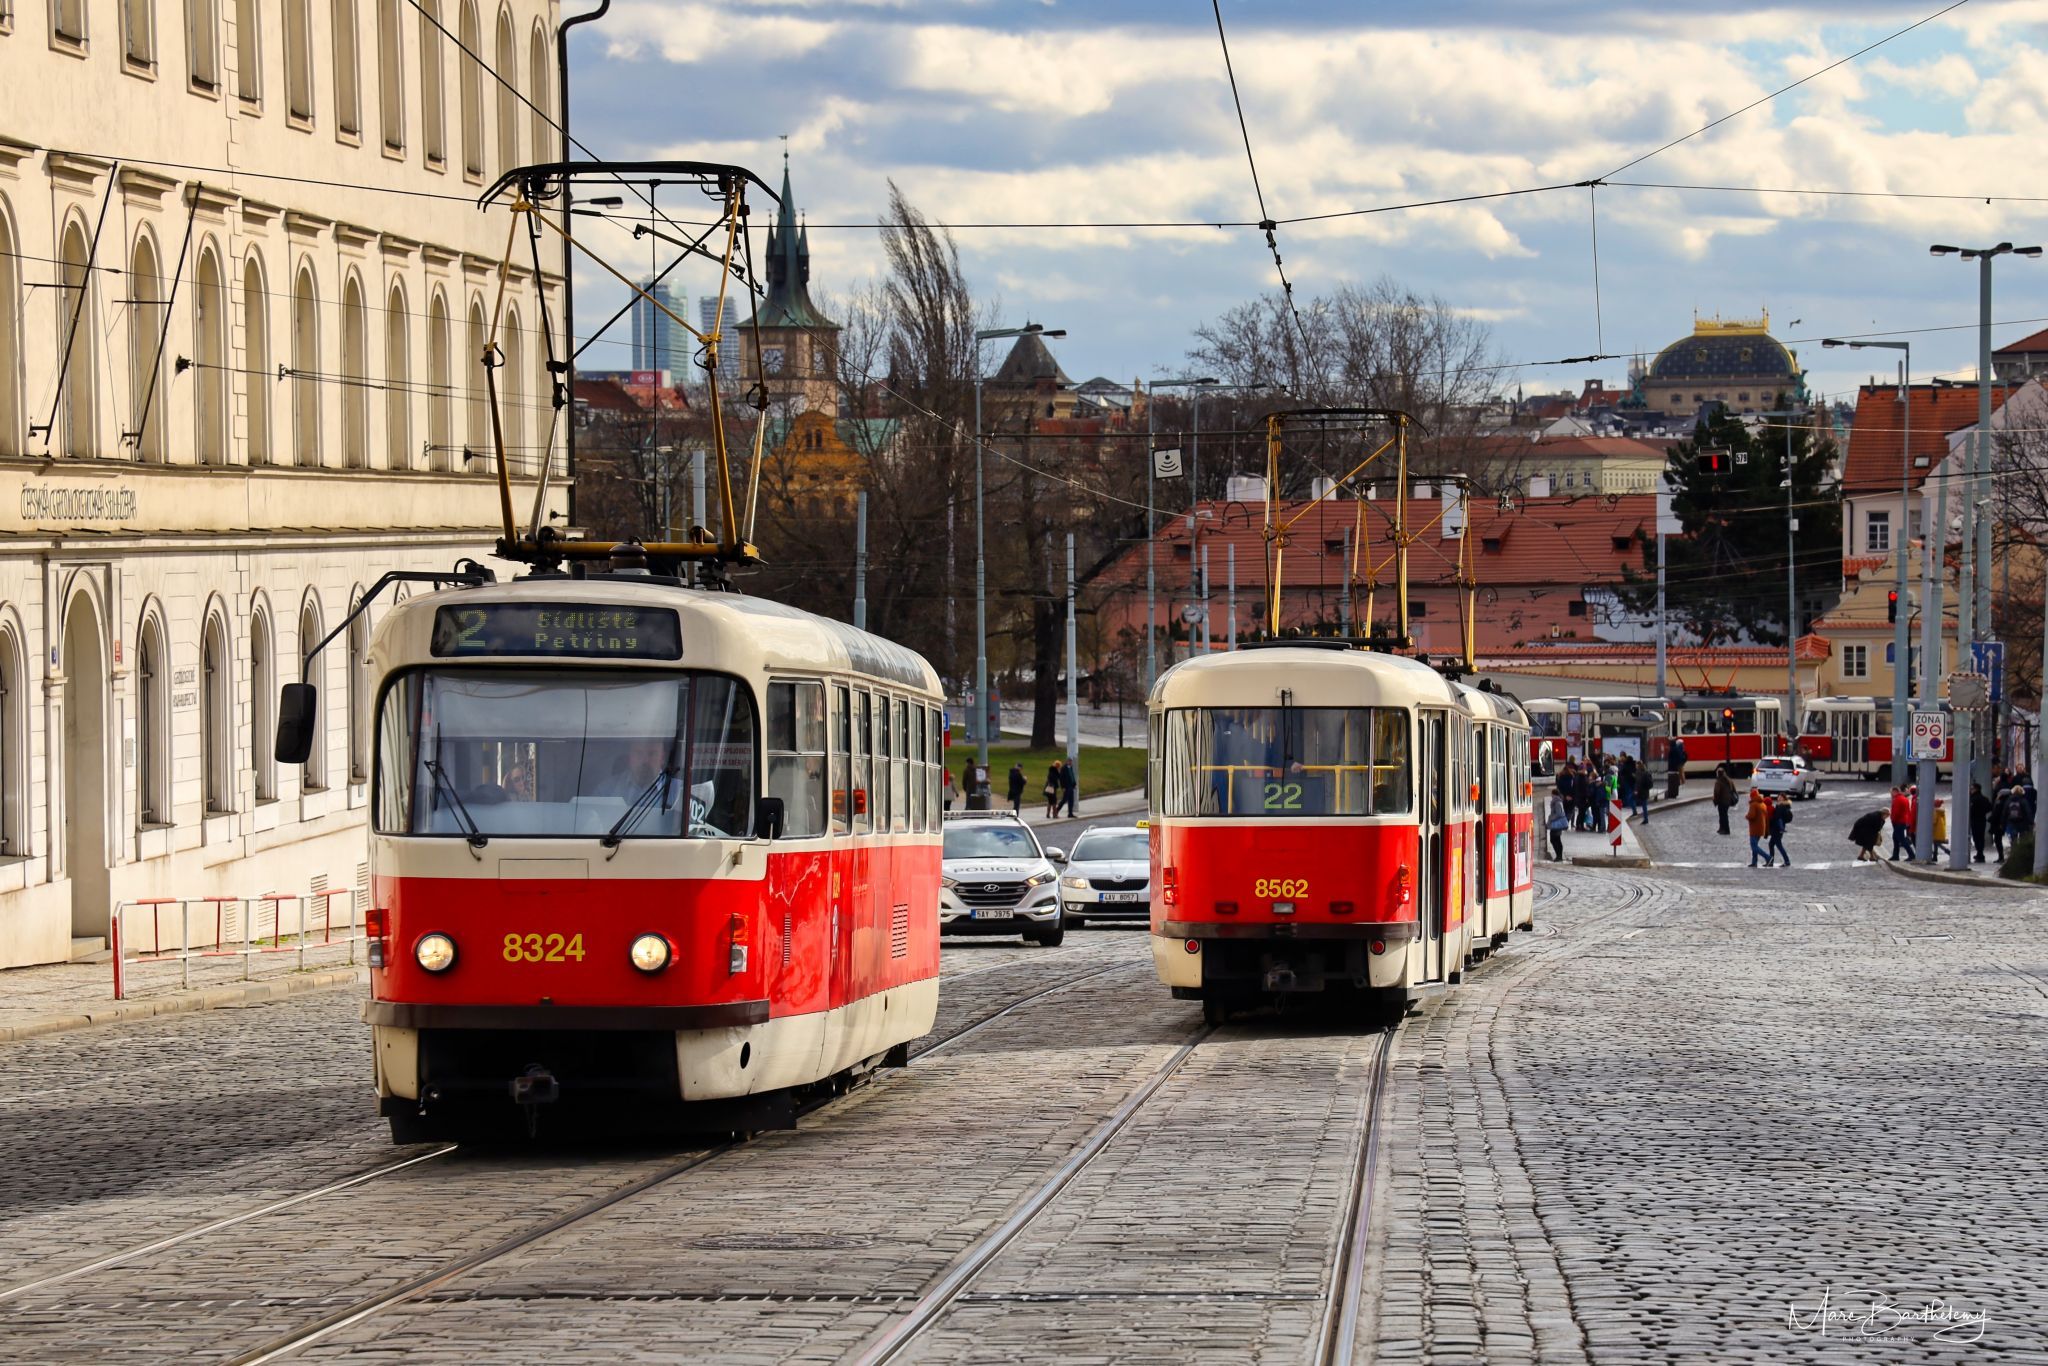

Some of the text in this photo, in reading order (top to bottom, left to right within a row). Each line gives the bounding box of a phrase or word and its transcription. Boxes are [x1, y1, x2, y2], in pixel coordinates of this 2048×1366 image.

[21, 481, 137, 520] ČESKÁ GEOLOGICKÁ SLUŽBA
[459, 609, 487, 647] 2
[538, 609, 637, 629] Sídliště
[535, 632, 637, 649] Petřiny
[1915, 714, 1941, 724] ZÓNA
[1264, 783, 1302, 809] 22
[1255, 879, 1309, 898] 8562
[503, 933, 586, 962] 8324
